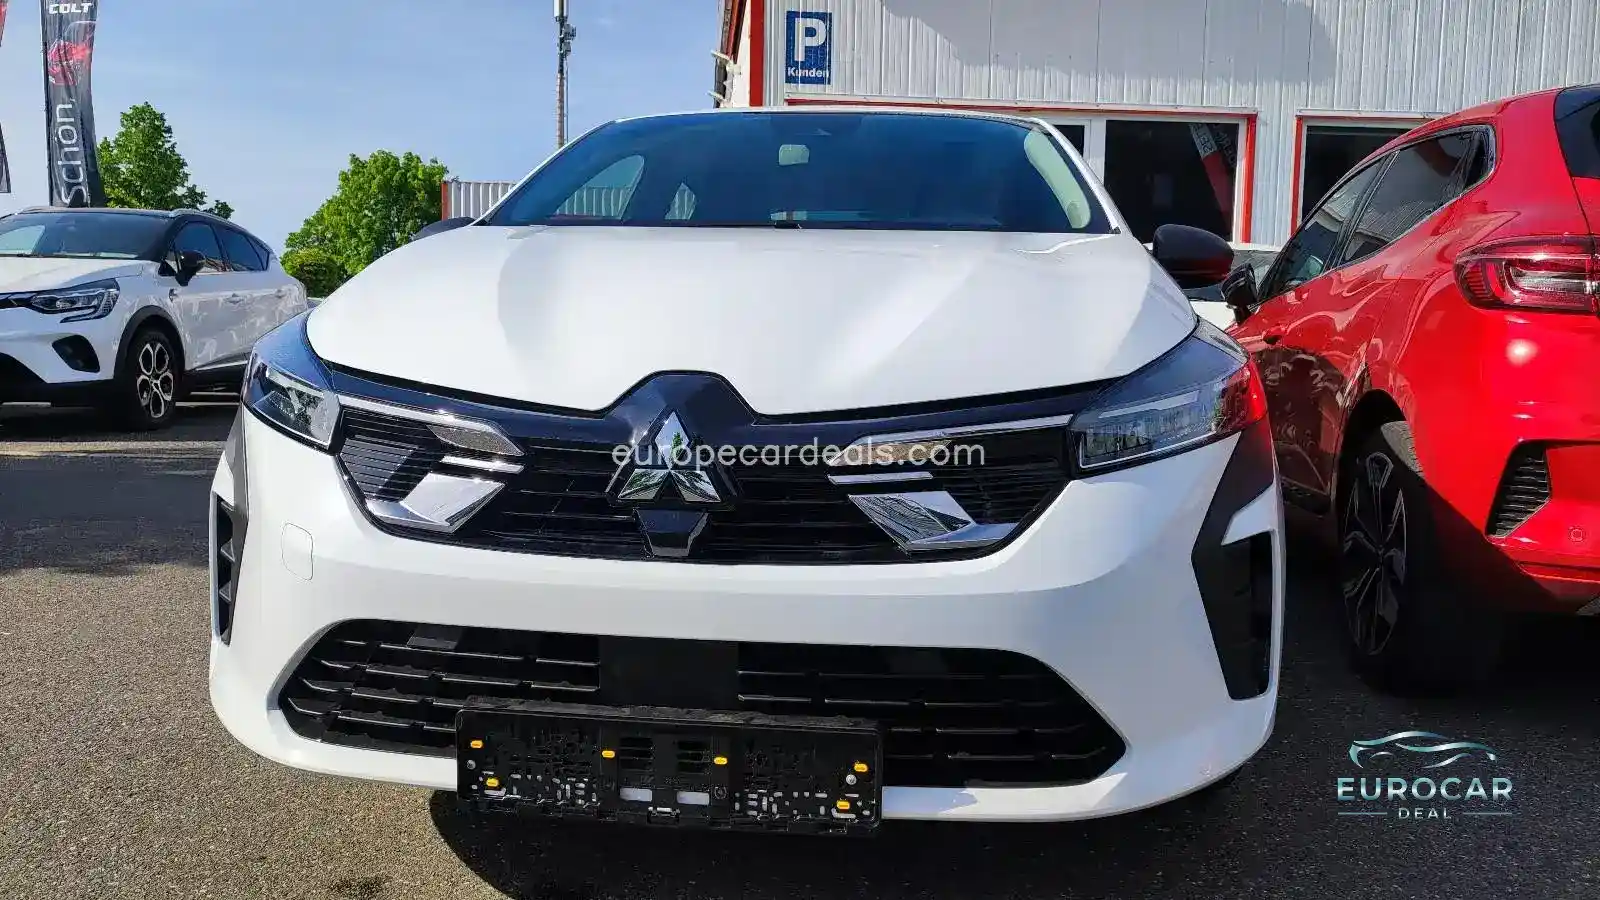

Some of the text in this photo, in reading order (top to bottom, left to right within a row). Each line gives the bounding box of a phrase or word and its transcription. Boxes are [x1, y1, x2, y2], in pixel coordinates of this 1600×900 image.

[48, 2, 94, 14] COLT
[793, 17, 828, 62] P
[787, 66, 830, 78] Kunden
